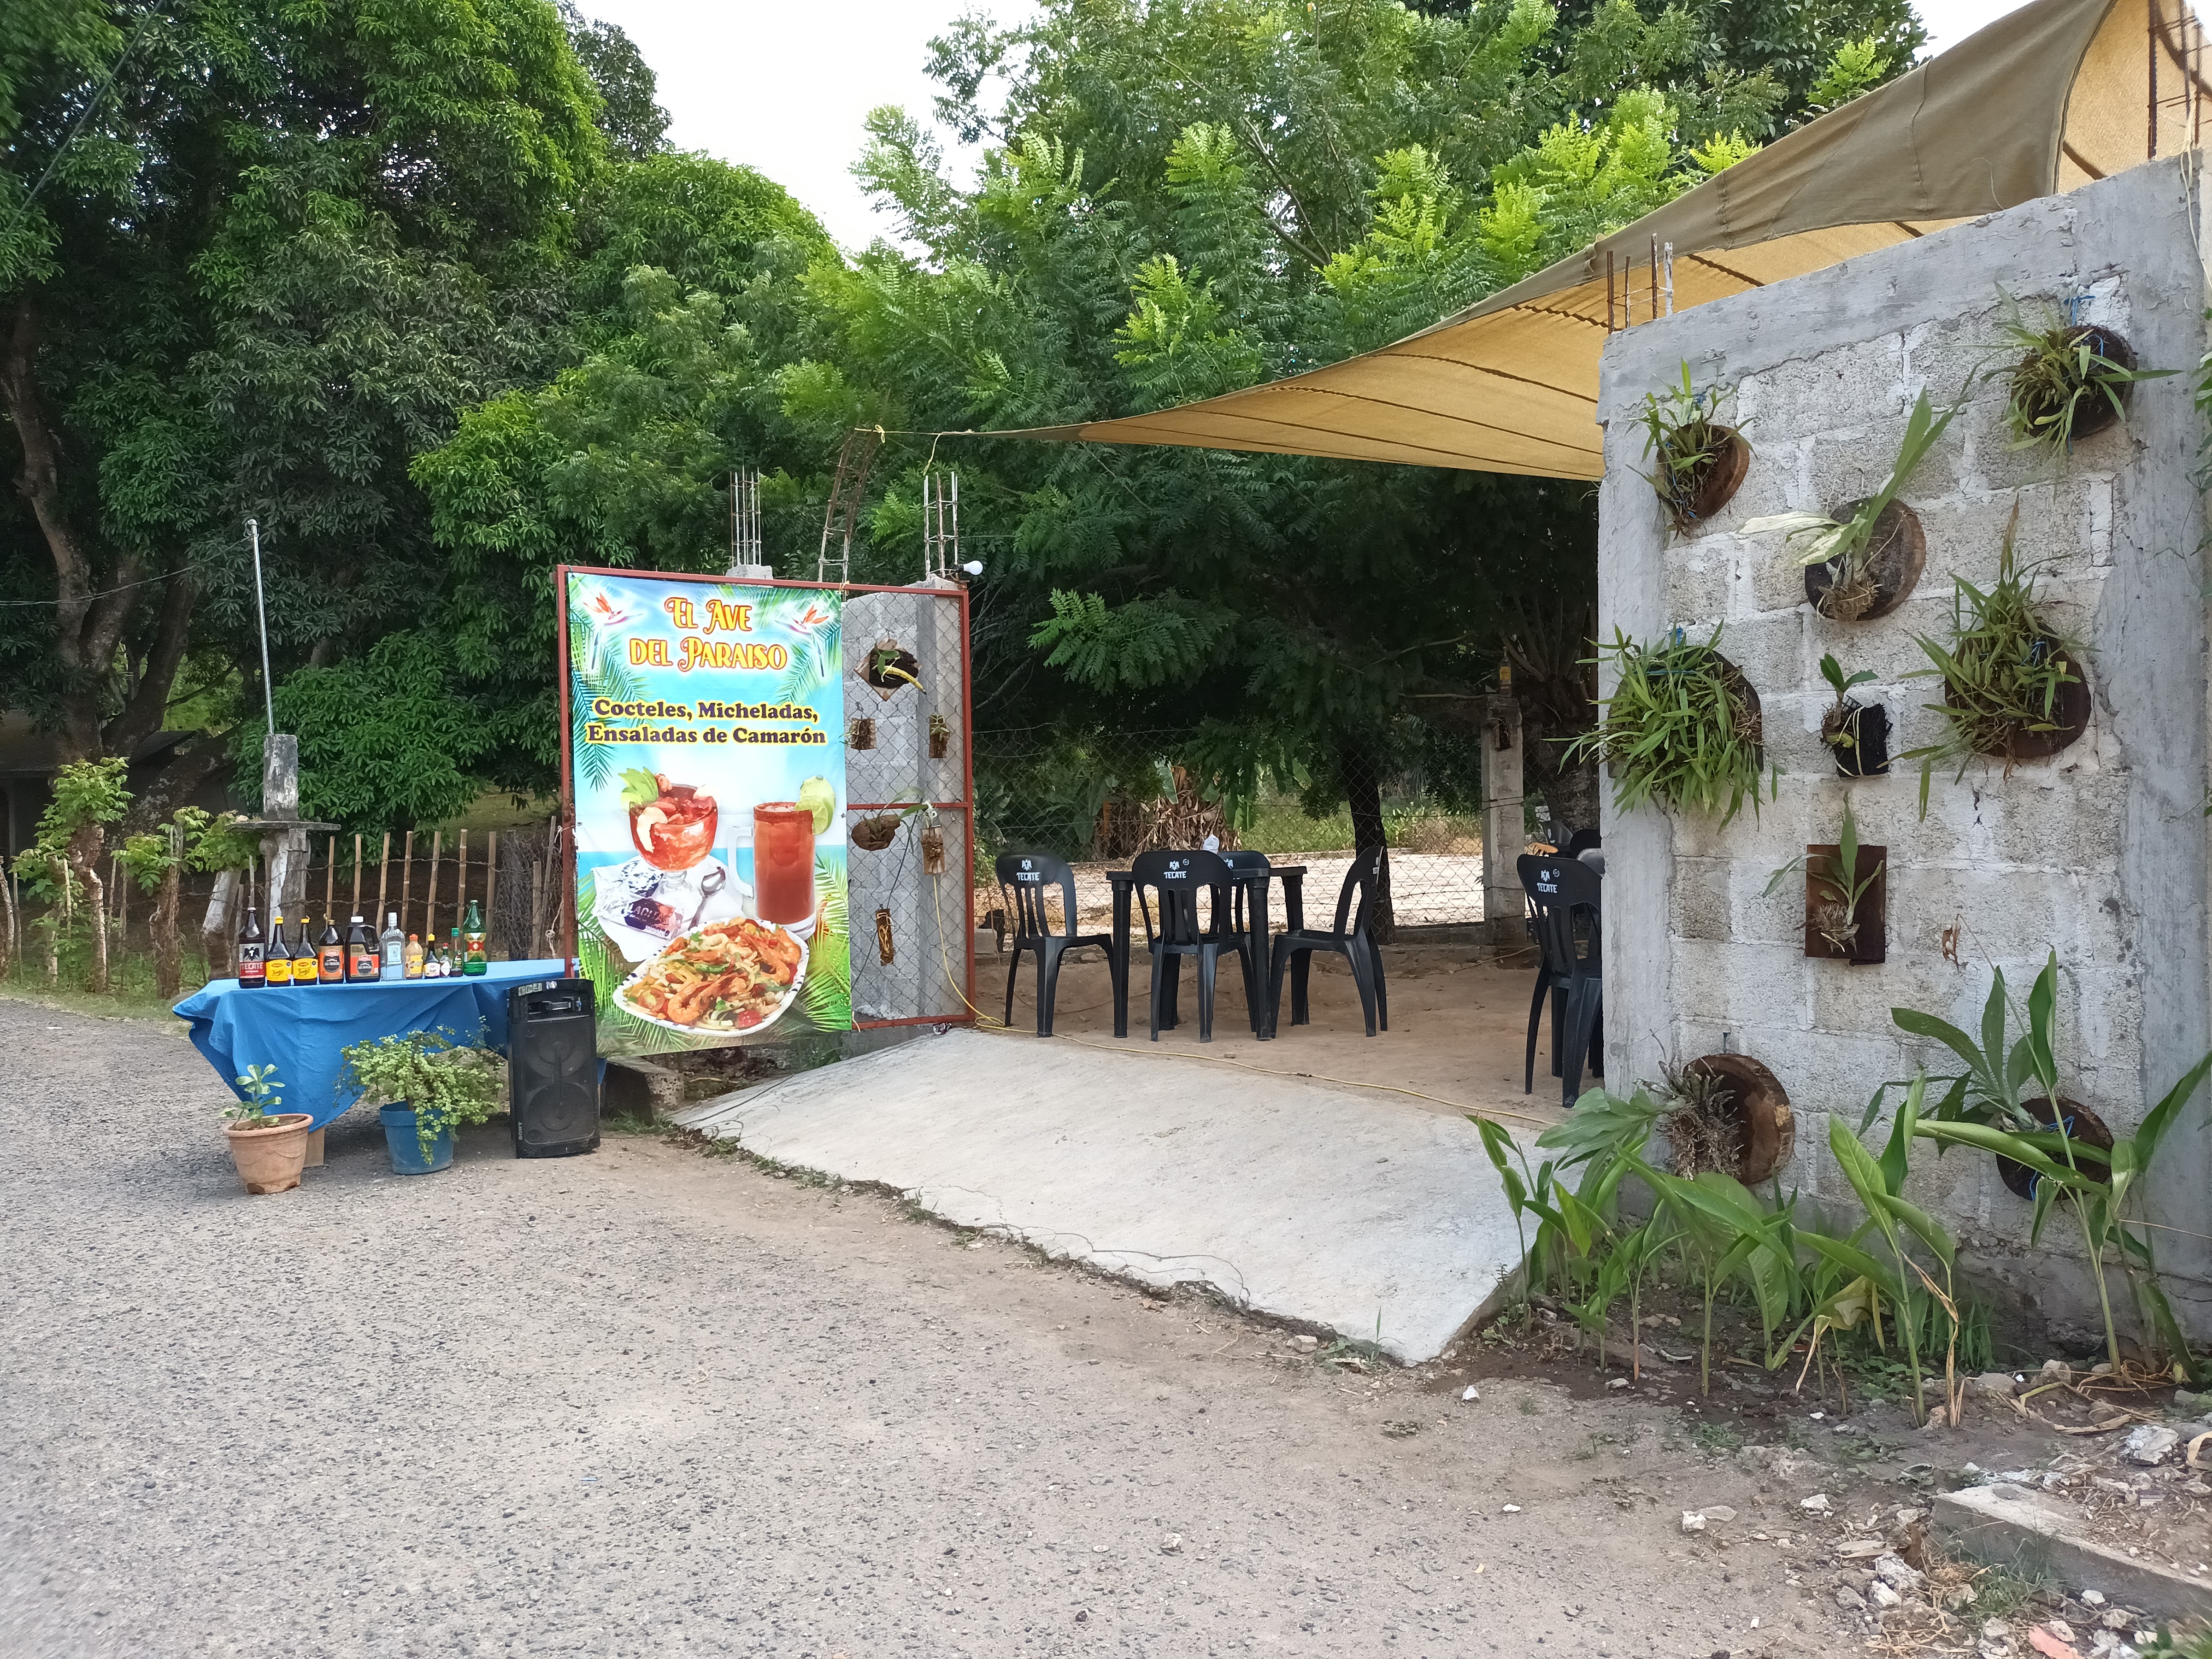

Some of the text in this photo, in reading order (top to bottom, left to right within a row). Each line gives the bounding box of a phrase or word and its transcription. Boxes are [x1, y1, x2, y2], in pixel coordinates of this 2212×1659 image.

[664, 597, 752, 635] EL AVE
[629, 636, 788, 672] DEL PARAISO
[595, 700, 818, 723] Cocteles, Micheladas,
[588, 725, 826, 743] Ensaladas de Camarón
[1016, 872, 1041, 881] TECATE
[1537, 882, 1557, 893] TECATE
